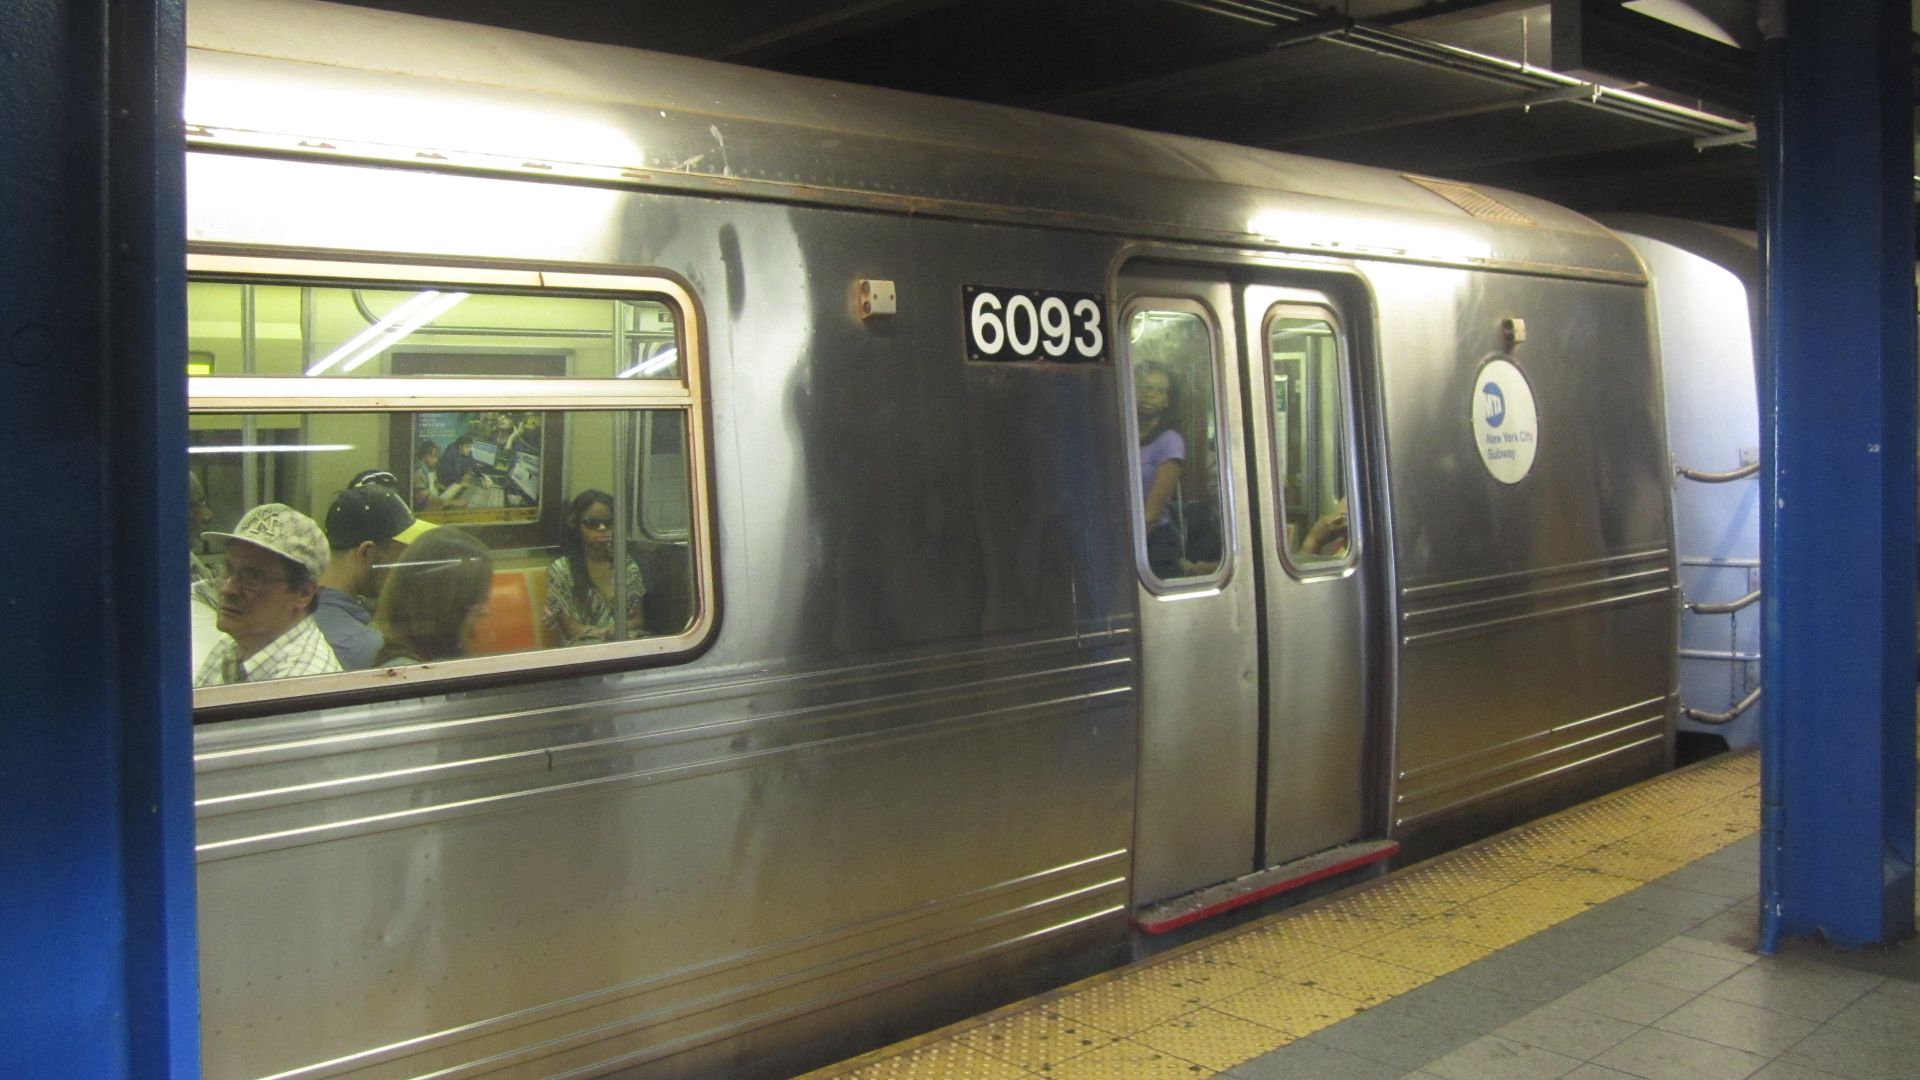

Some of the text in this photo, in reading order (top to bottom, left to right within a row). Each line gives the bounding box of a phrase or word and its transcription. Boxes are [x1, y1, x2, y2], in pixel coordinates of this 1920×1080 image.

[971, 292, 1103, 357] 6093
[1486, 431, 1533, 445] New York City
[1487, 448, 1516, 460] Subway
